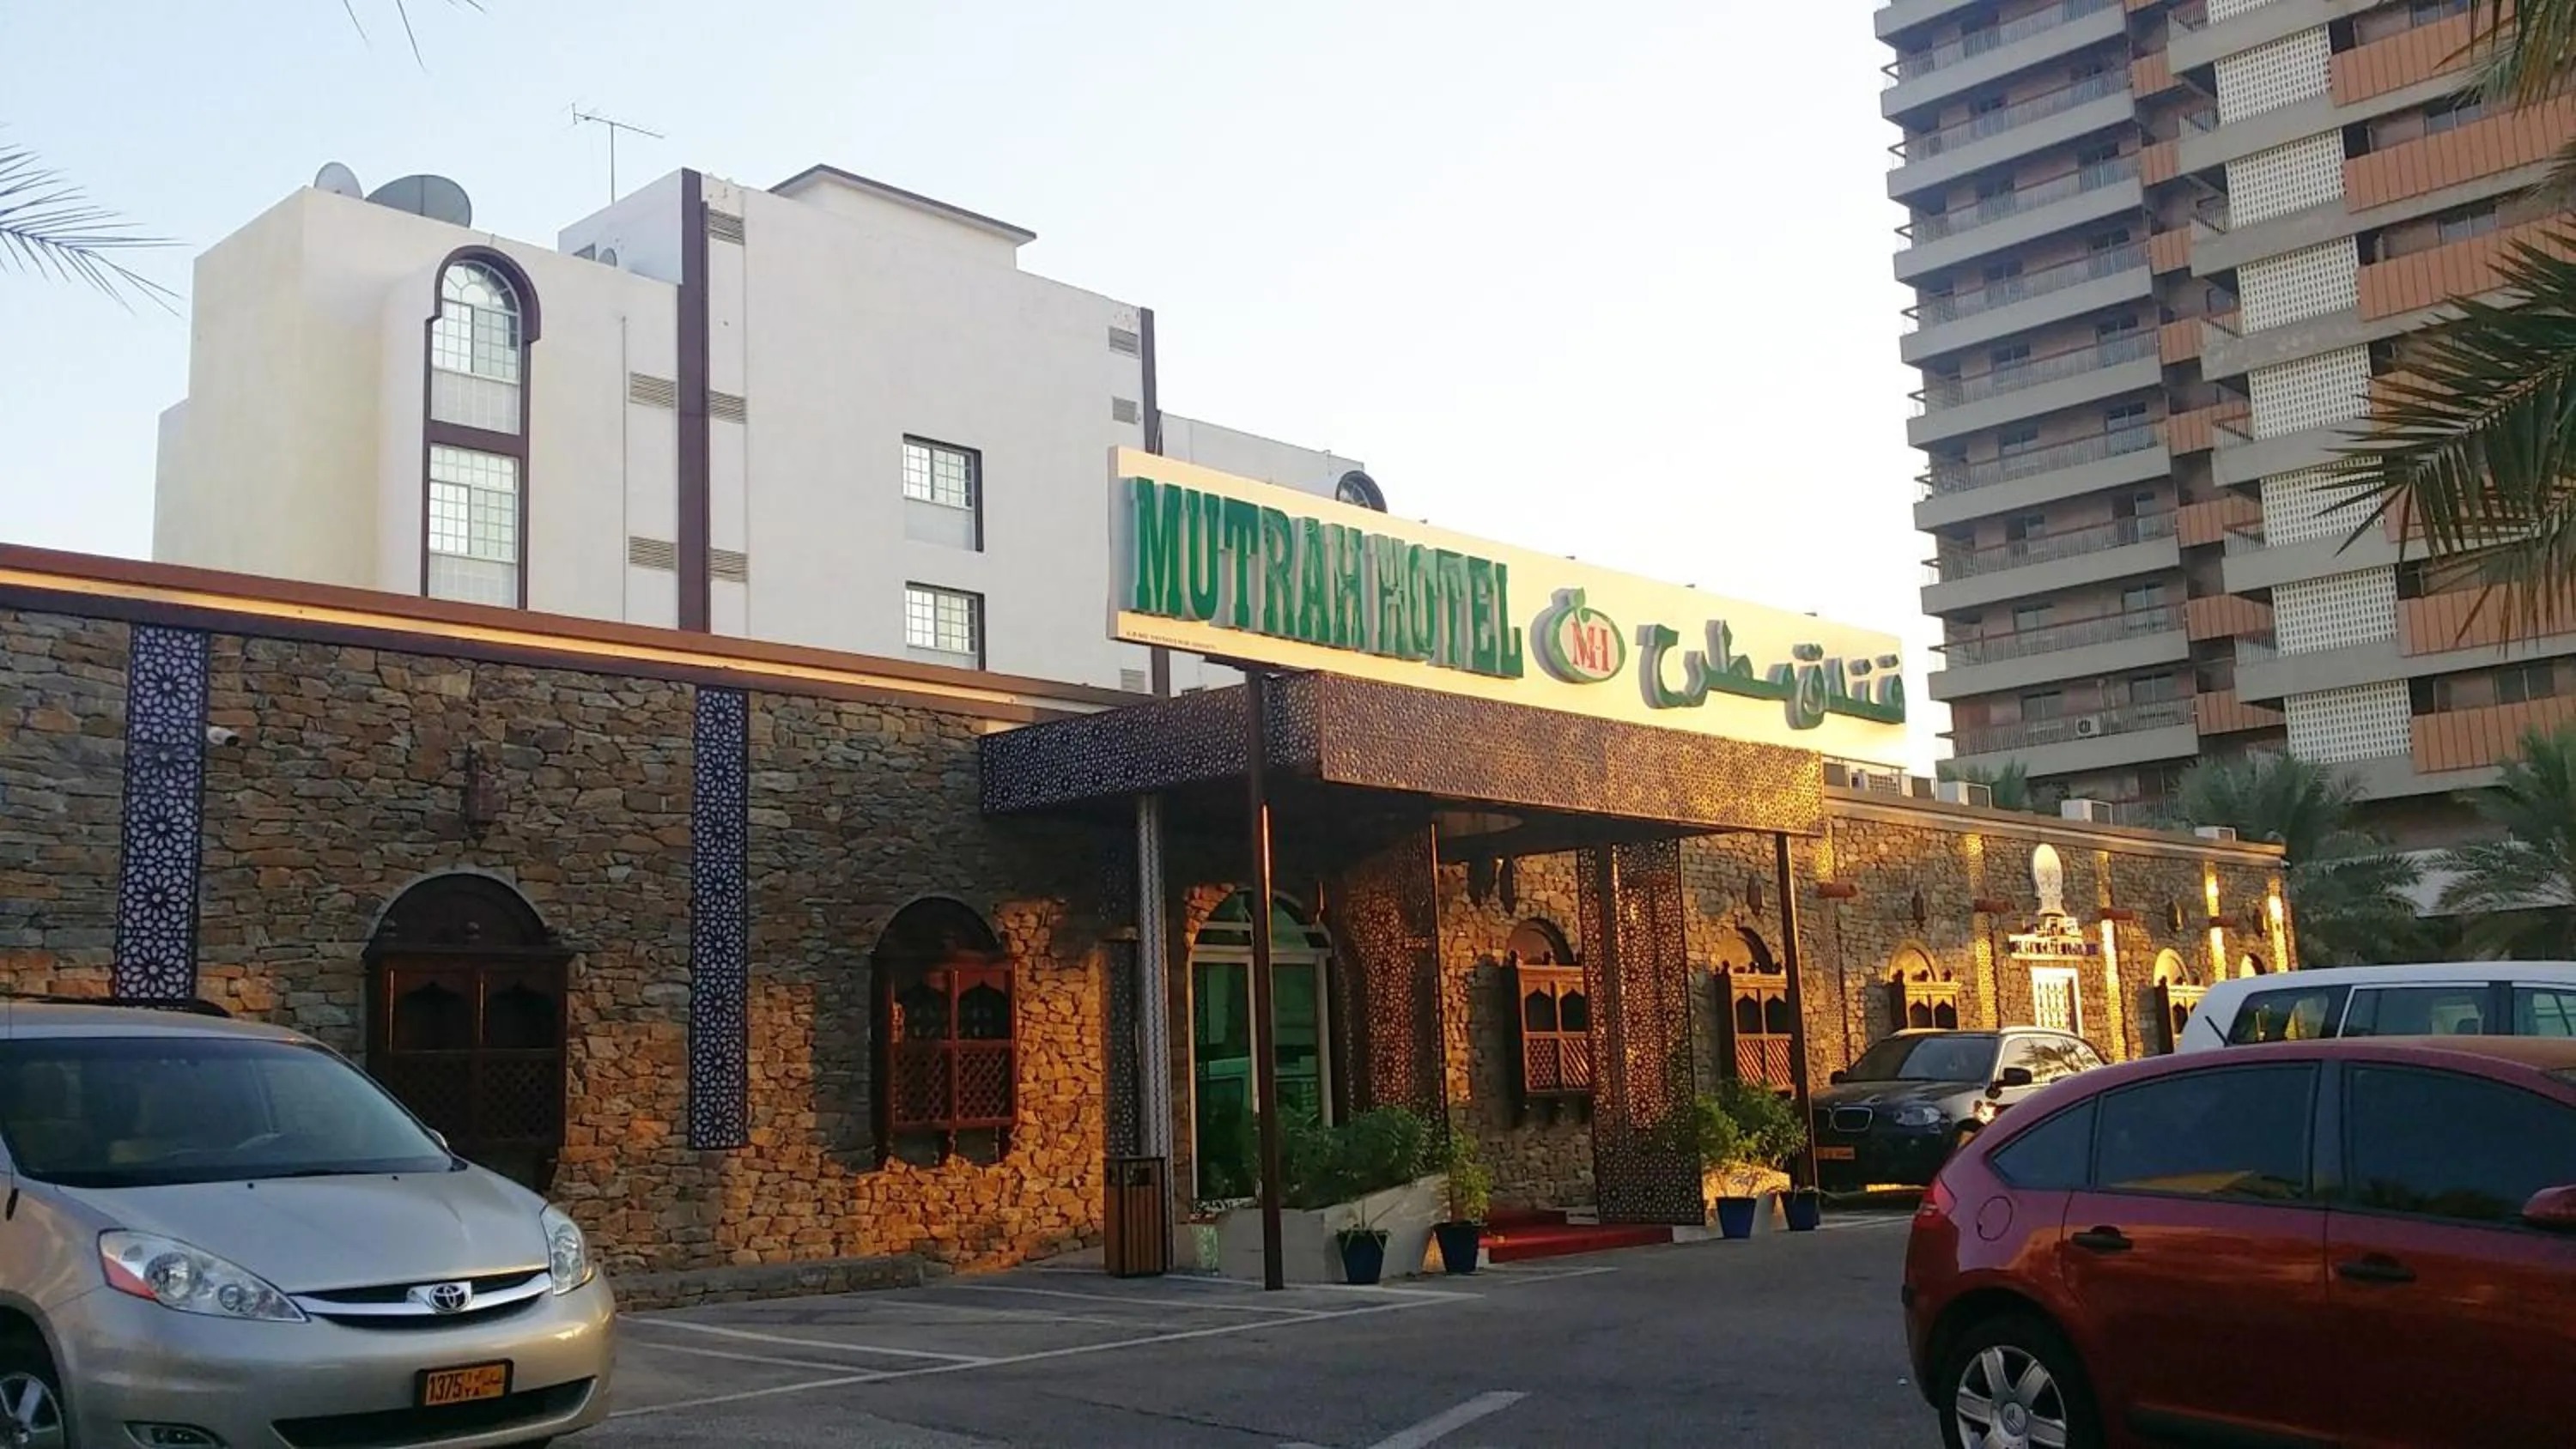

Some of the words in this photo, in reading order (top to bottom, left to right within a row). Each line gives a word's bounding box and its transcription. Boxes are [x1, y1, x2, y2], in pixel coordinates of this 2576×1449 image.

[1131, 476, 1366, 652] MUTRAH
[1365, 532, 1524, 679] HOTEL
[1635, 619, 1795, 710] مطرح
[1784, 644, 1906, 731] فندق
[428, 1373, 463, 1403] 1375
